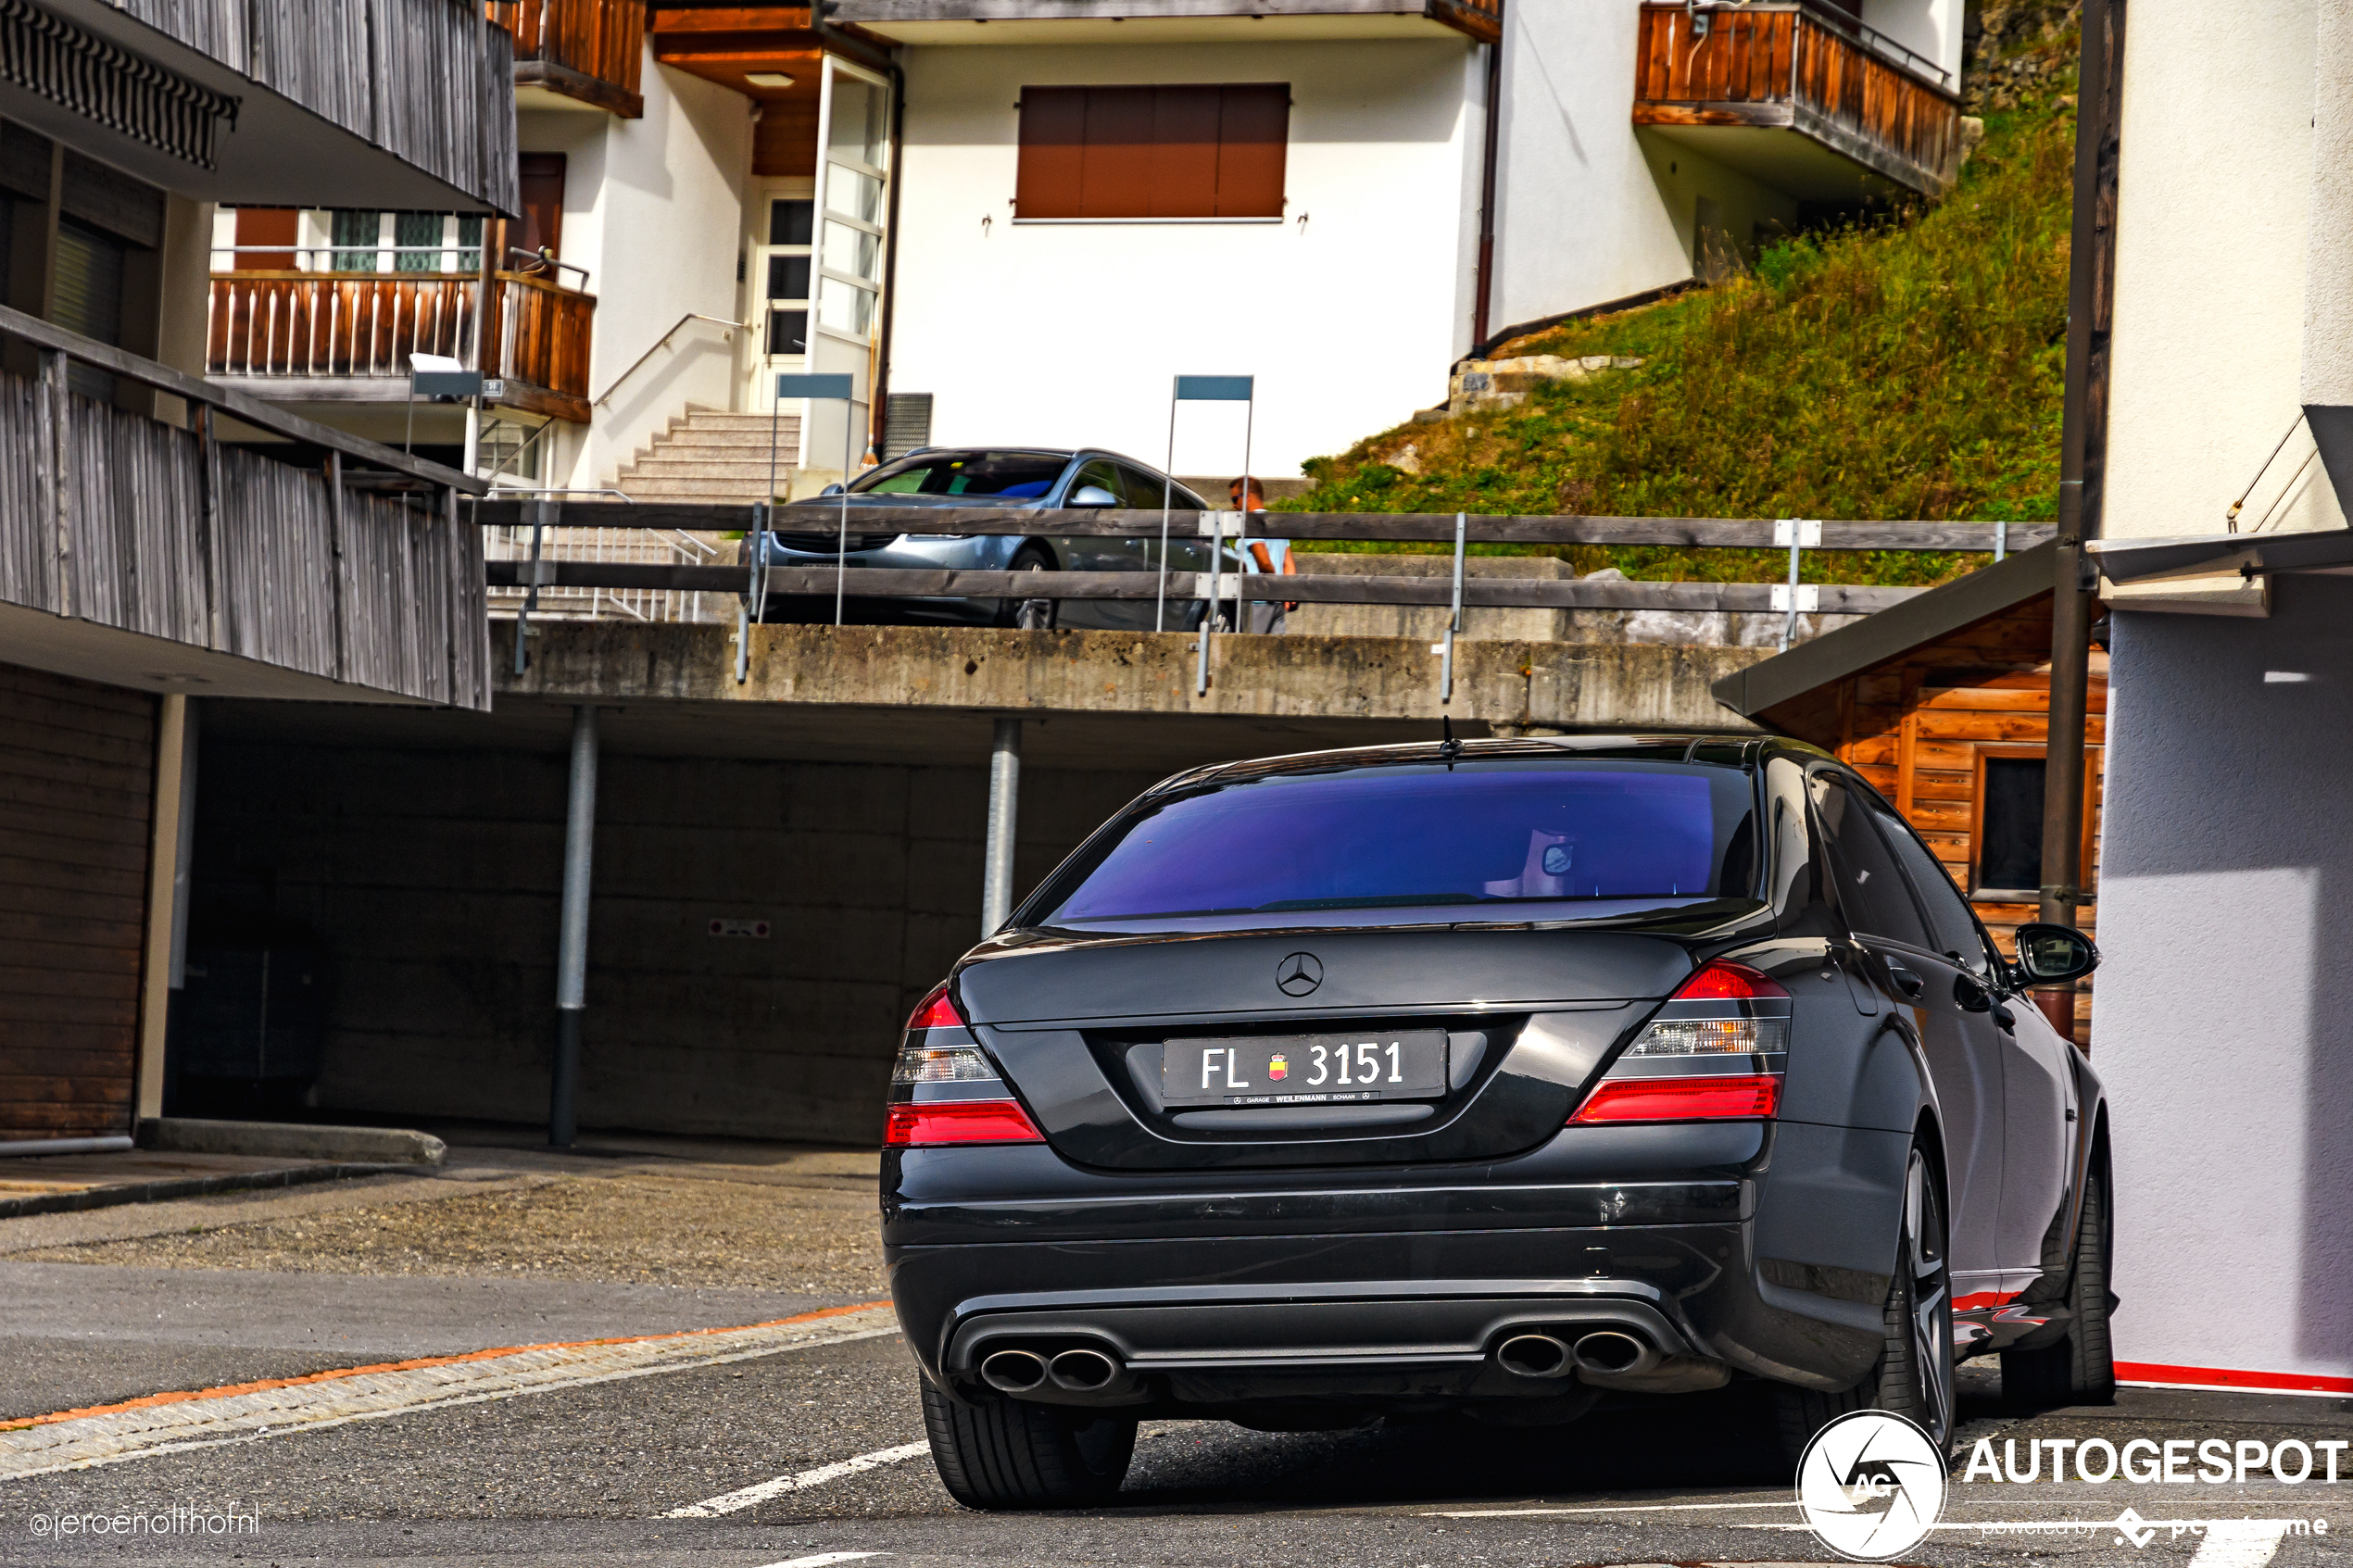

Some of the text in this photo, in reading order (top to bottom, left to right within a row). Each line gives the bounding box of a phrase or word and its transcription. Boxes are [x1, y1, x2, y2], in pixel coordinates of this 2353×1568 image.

[1201, 1041, 1403, 1089] FL 3151
[1276, 1094, 1327, 1103] WEILENMANN
